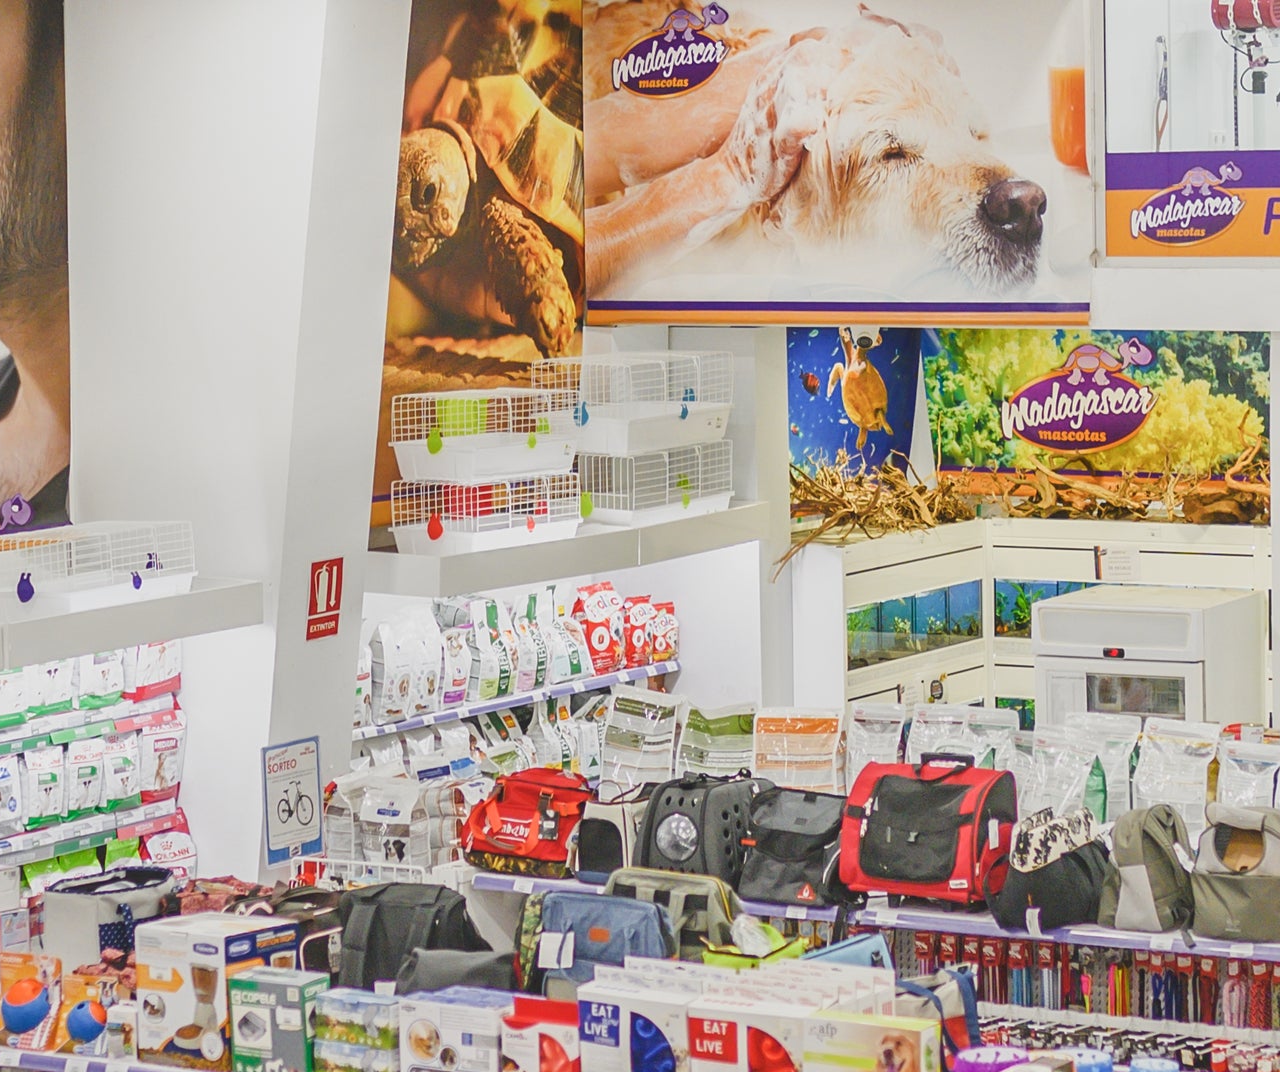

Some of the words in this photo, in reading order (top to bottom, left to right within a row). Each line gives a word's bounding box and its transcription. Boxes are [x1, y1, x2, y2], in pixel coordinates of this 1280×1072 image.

[613, 40, 729, 89] Madagascar
[639, 78, 688, 88] mascotas
[1131, 194, 1246, 237] Madagascar
[1156, 227, 1206, 238] mascotas
[1002, 382, 1160, 439] Madagascar
[1038, 429, 1106, 442] mascotas
[309, 620, 336, 633] EXTINTOR
[267, 759, 297, 774] SORTEO
[241, 993, 276, 1005] COPELE
[591, 1003, 614, 1018] EAT
[584, 1022, 609, 1037] LIVE
[703, 1020, 728, 1036] EAT
[818, 1023, 838, 1037] afp
[695, 1039, 724, 1055] LIVE
